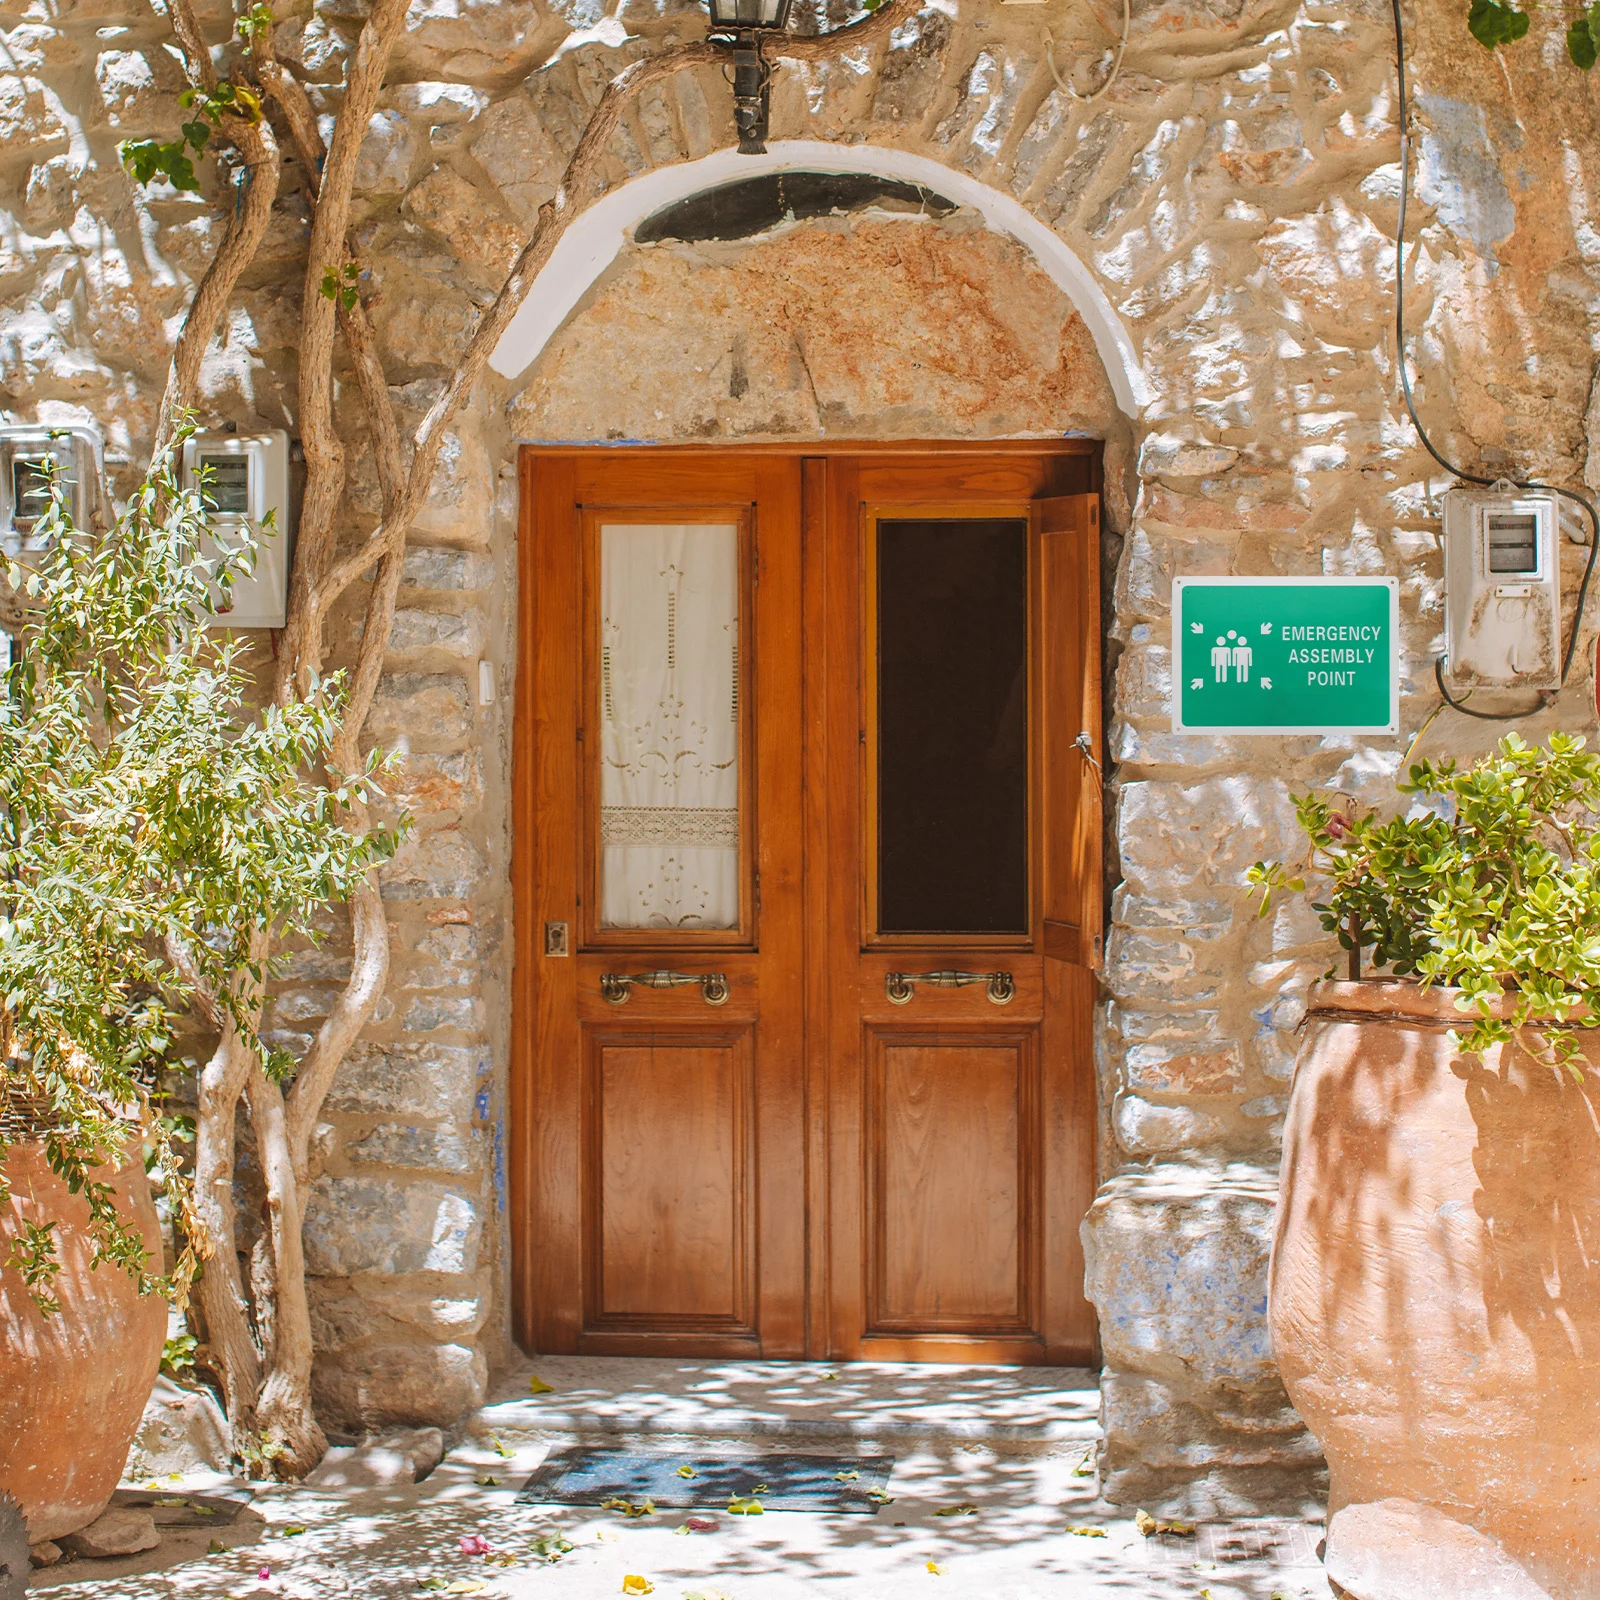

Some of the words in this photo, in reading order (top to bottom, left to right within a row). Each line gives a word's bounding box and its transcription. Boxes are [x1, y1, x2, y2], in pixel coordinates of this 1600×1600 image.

[1282, 626, 1382, 641] EMERGENCY
[1288, 648, 1375, 664] ASSEMBLY
[1307, 671, 1356, 686] POINT
